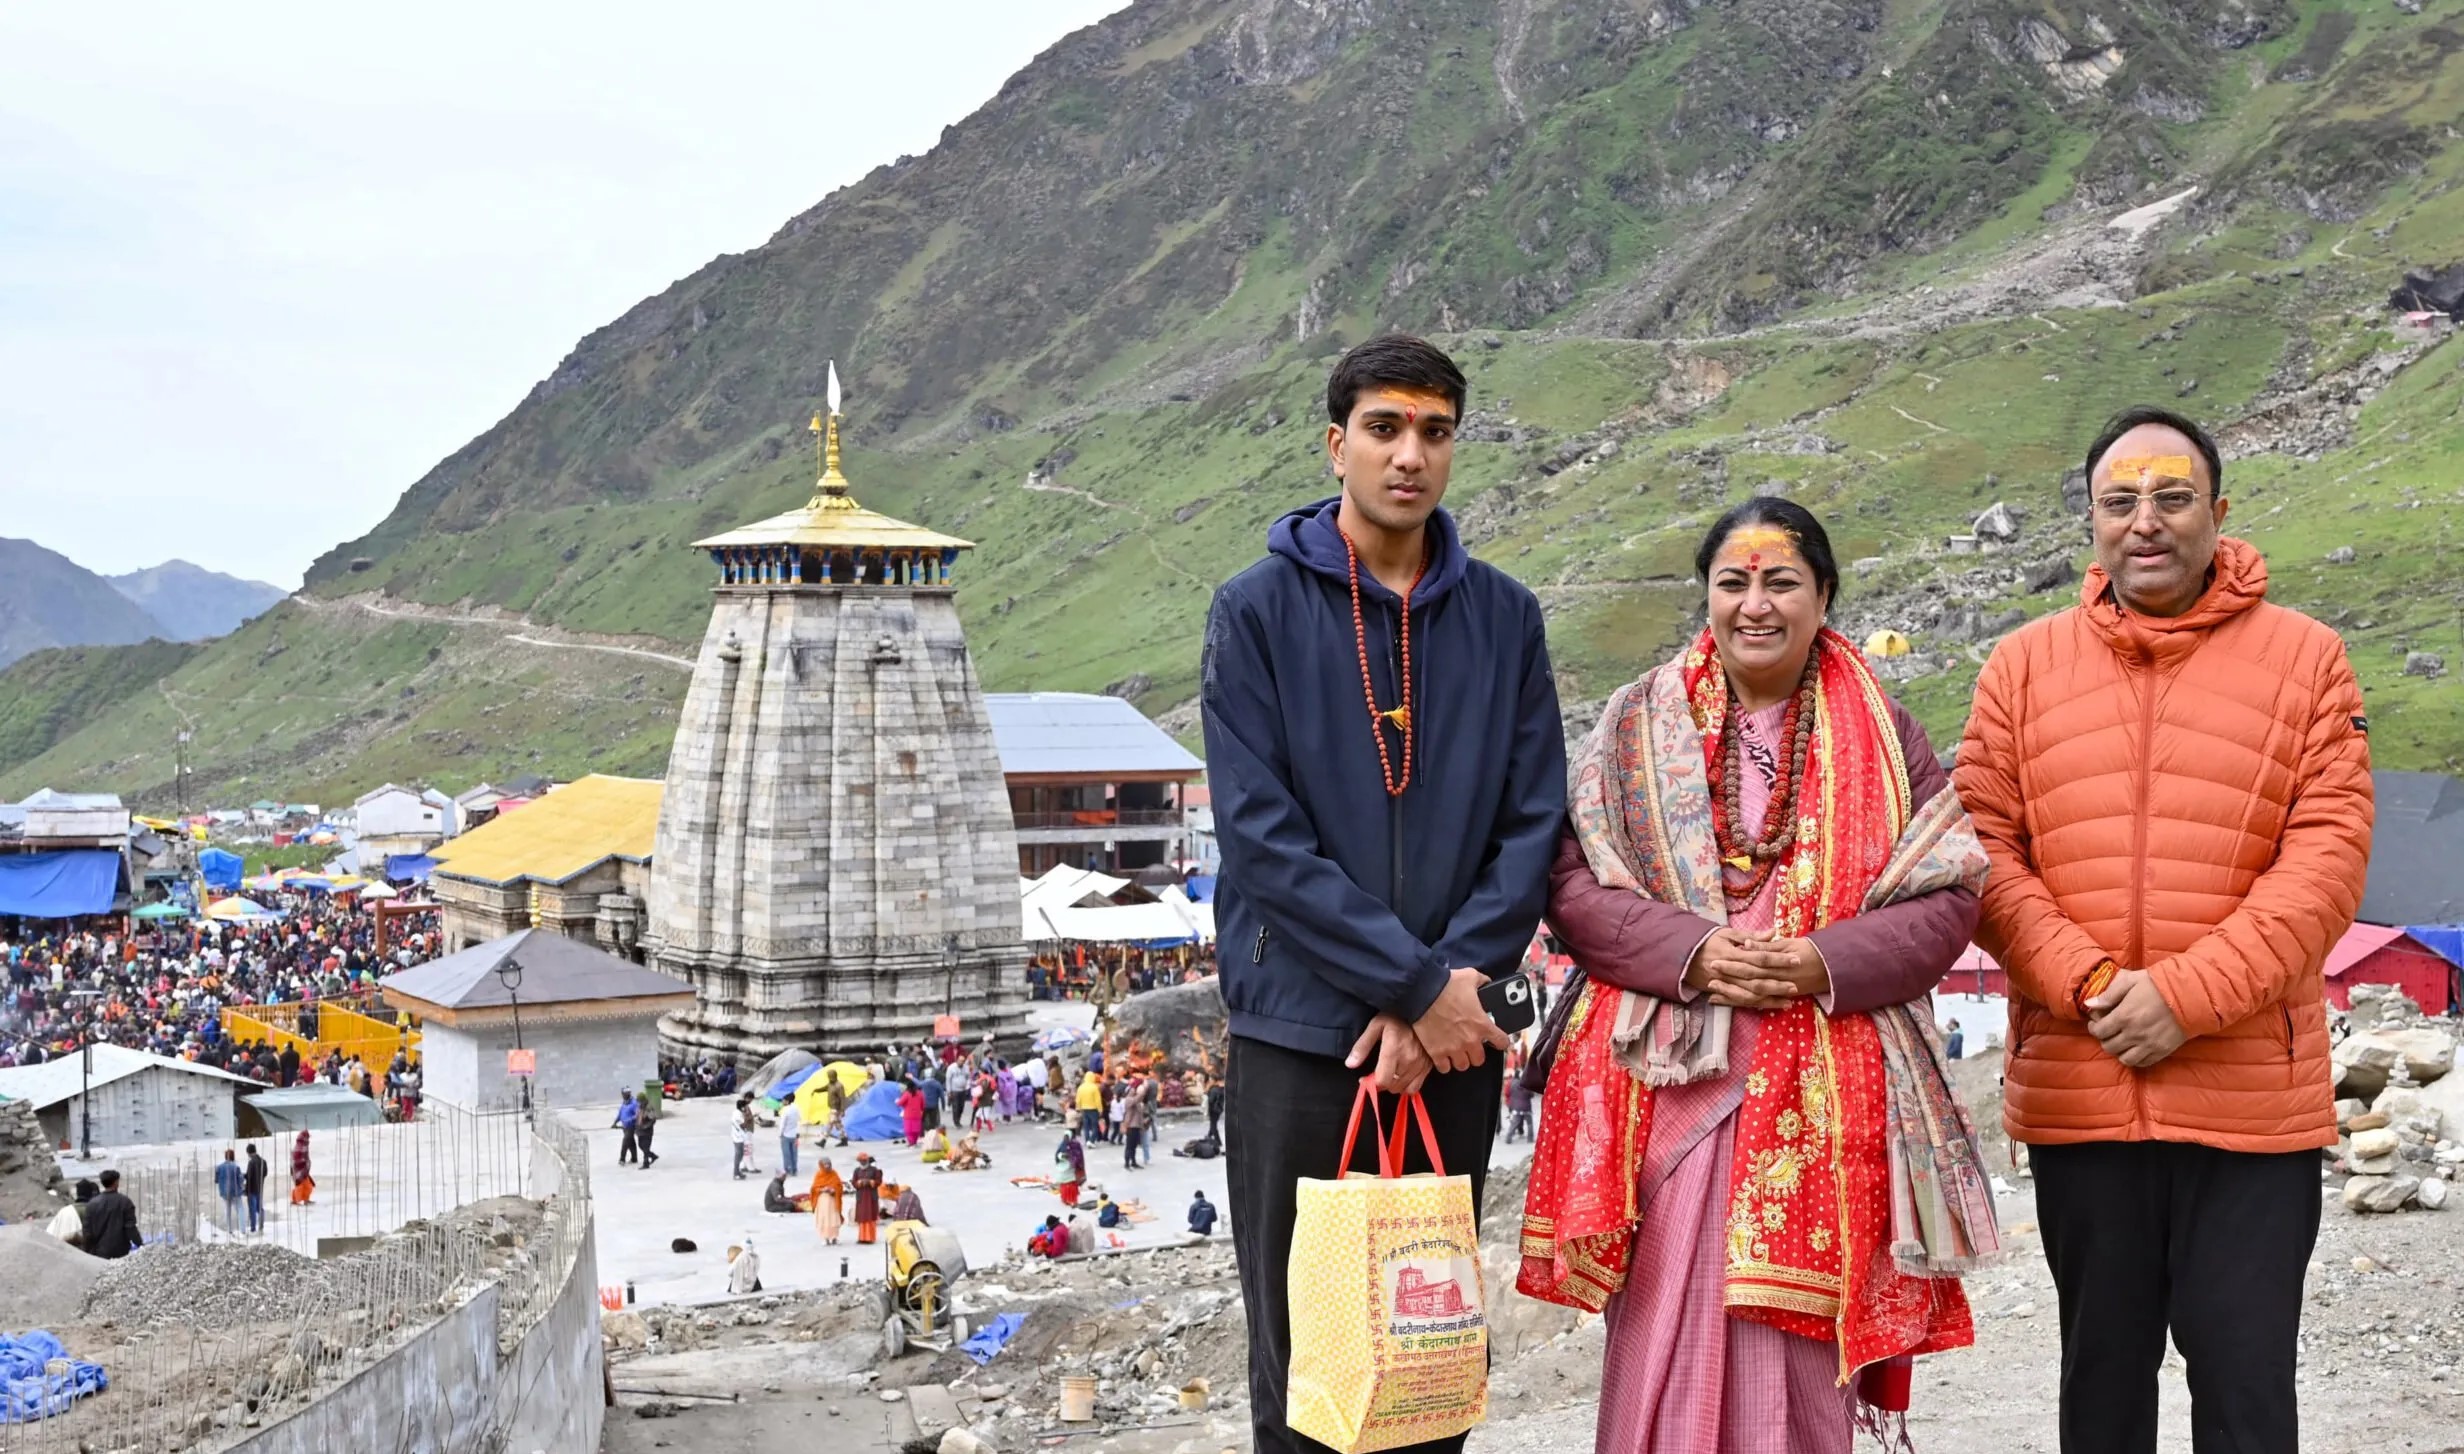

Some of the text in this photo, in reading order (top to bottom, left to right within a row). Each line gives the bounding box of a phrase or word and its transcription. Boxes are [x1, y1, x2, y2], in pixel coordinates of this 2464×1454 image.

[1399, 1240, 1419, 1256] बदरी
[1401, 1332, 1477, 1350] श्री केदारनाथ धाम
